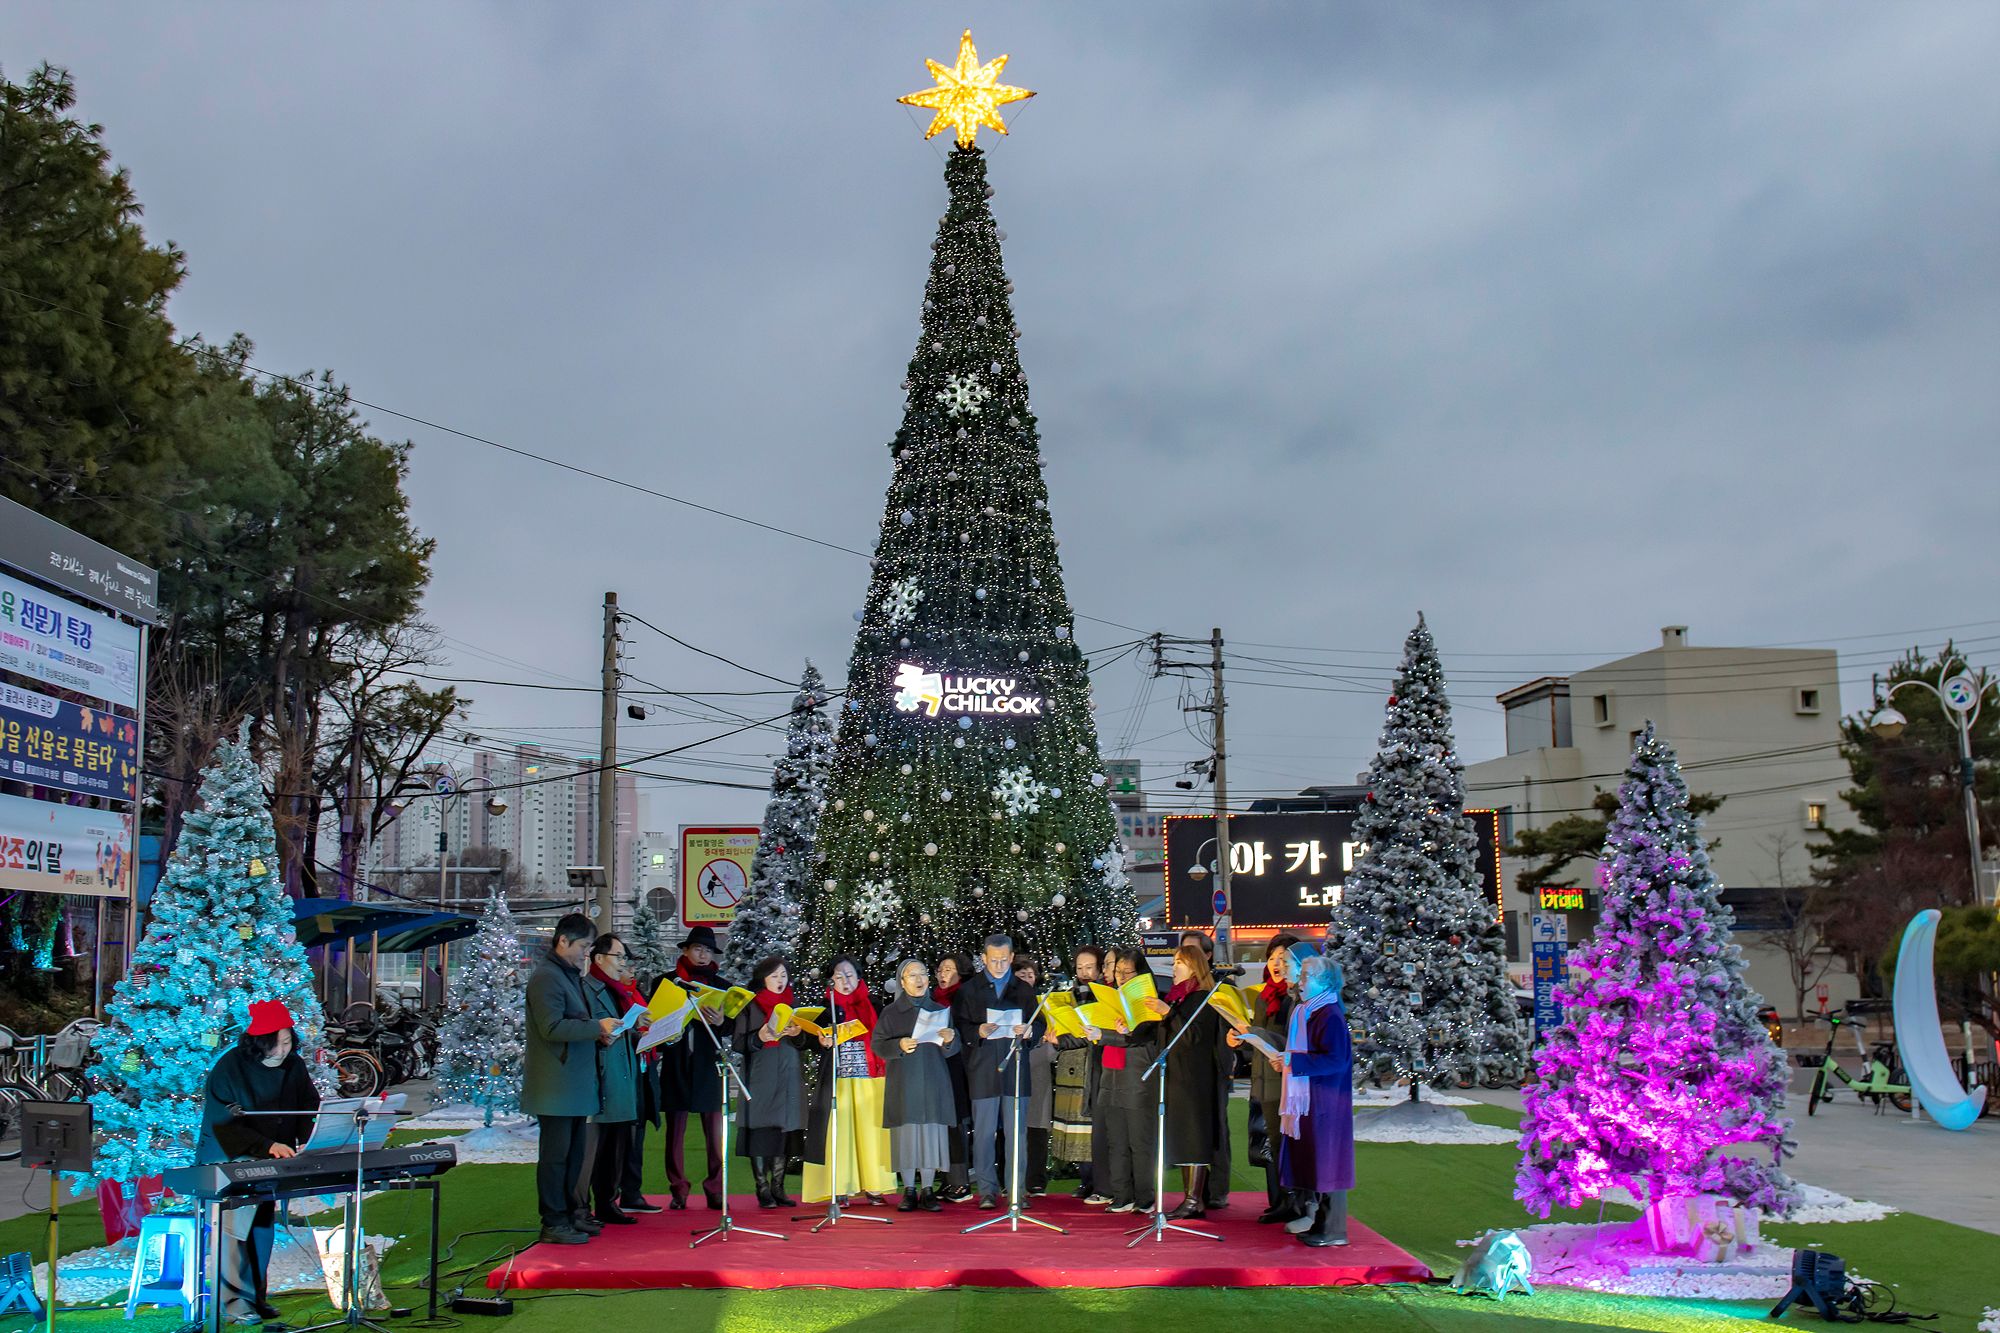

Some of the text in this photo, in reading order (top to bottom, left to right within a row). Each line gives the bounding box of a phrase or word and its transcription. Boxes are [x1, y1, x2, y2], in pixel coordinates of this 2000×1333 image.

[20, 598, 62, 639] 전문가
[67, 616, 92, 650] 특강
[944, 677, 1016, 695] LUCKY
[40, 698, 53, 715] 공연
[943, 694, 1041, 714] CHILGOK
[25, 726, 69, 761] 선율로
[46, 842, 63, 874] 달
[1533, 917, 1541, 927] P
[244, 1166, 278, 1178] YAMAHA
